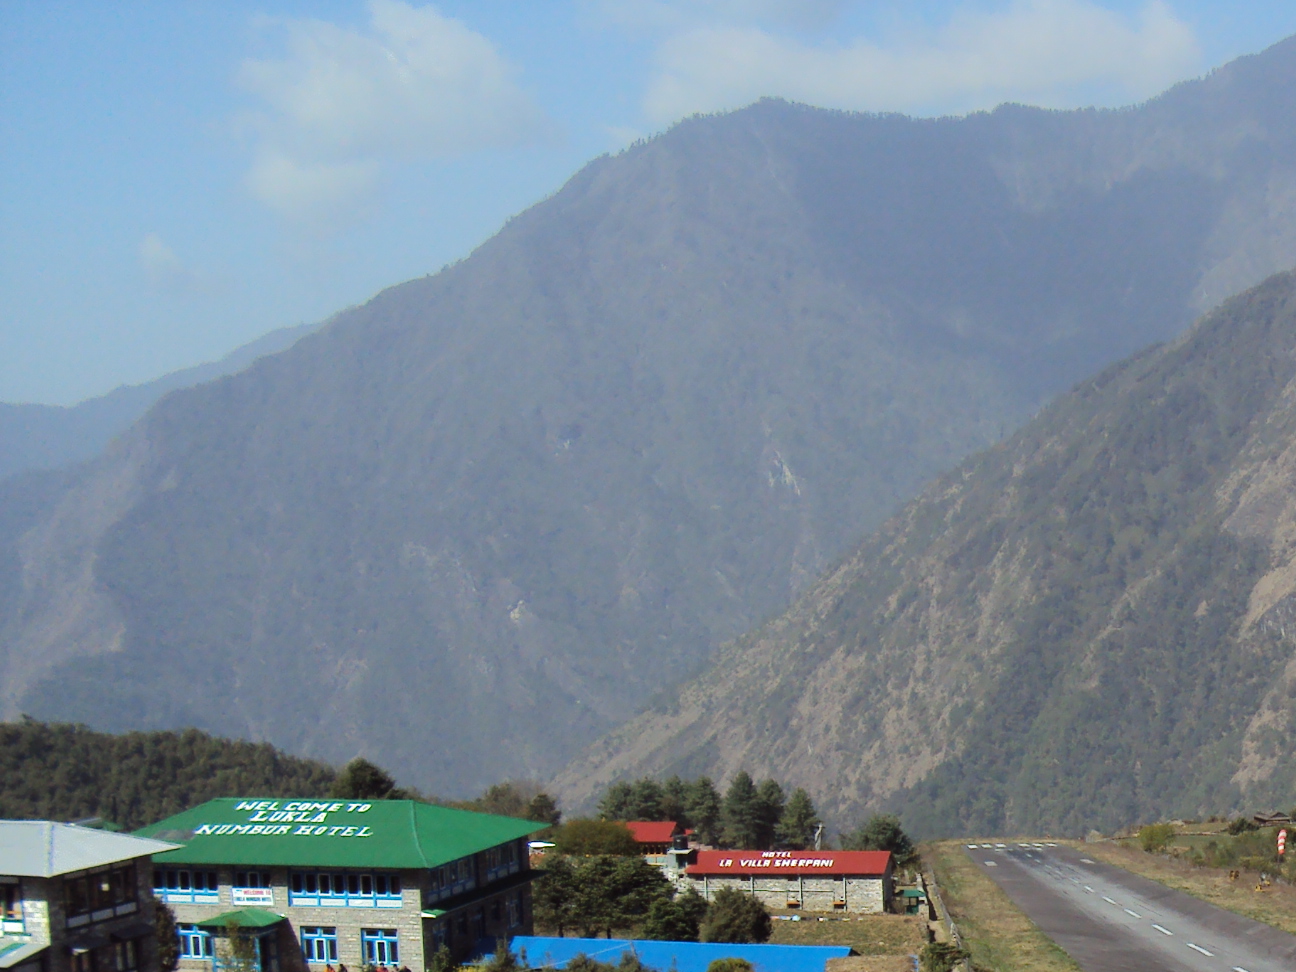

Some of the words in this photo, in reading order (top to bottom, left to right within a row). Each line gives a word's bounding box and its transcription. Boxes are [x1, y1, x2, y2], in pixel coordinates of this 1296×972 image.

[347, 803, 372, 812] TO
[249, 811, 327, 822] LUKLA
[194, 825, 291, 835] NUMBUR
[293, 825, 374, 837] HOTEL
[719, 859, 733, 867] LA
[740, 859, 770, 867] VILLA
[774, 859, 834, 868] SHERPANI
